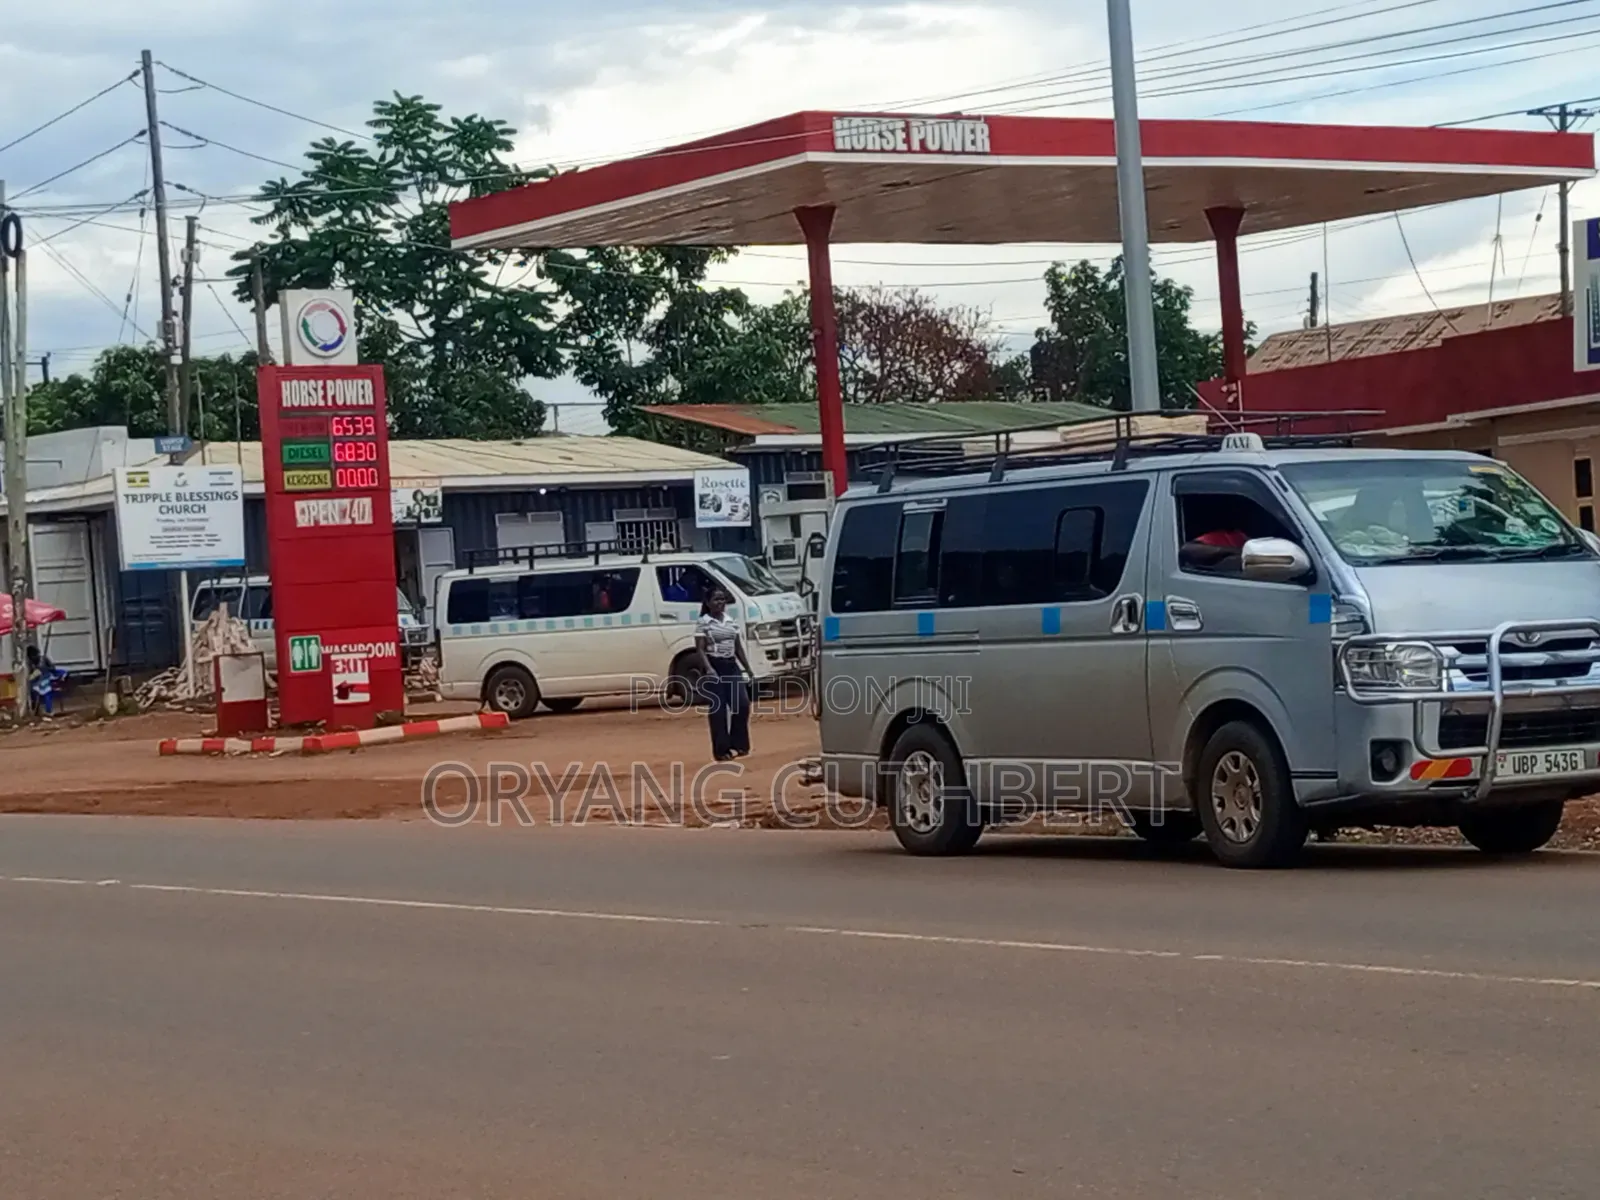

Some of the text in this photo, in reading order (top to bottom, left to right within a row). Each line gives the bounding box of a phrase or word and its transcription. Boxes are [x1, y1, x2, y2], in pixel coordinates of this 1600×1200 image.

[833, 117, 991, 152] HORSE POWER
[281, 378, 374, 407] HORSE POWER
[332, 416, 376, 436] 6539
[288, 442, 377, 461] DIESEL 6830
[1226, 436, 1249, 449] TAXI
[286, 468, 379, 487] KEROSENE 0000
[124, 490, 238, 503] TRIPPLE BLESSINGS
[158, 504, 206, 515] CHURCH
[297, 500, 339, 527] OPEN
[333, 658, 368, 674] EXIT
[1512, 752, 1578, 774] UBP 543G
